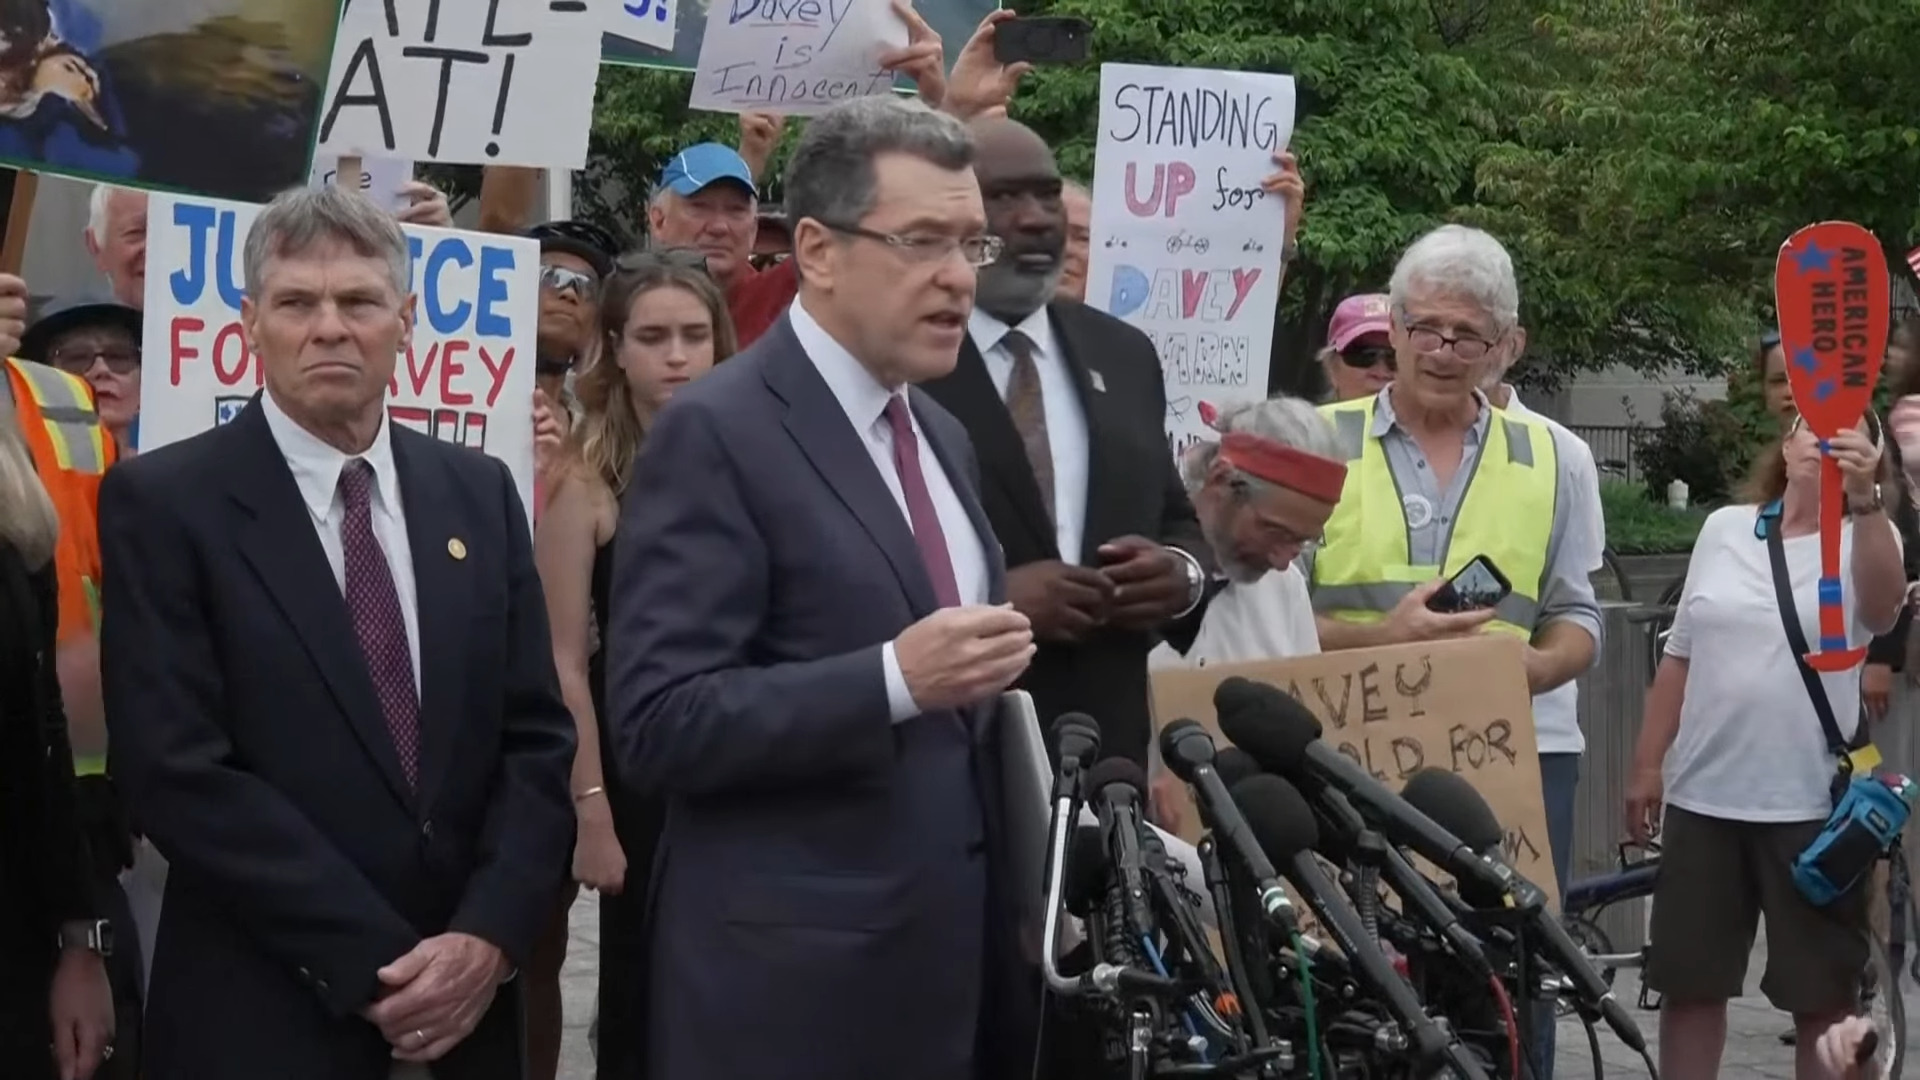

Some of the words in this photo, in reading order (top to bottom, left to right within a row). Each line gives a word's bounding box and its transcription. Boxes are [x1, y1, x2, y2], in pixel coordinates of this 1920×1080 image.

[775, 36, 812, 65] is
[1110, 84, 1277, 151] STANDING
[1125, 162, 1196, 218] UP
[1213, 166, 1265, 212] for
[1109, 264, 1261, 321] DAVEY
[1811, 281, 1837, 353] HERO
[1842, 247, 1869, 388] AMERICAN
[1449, 718, 1517, 772] FOR
